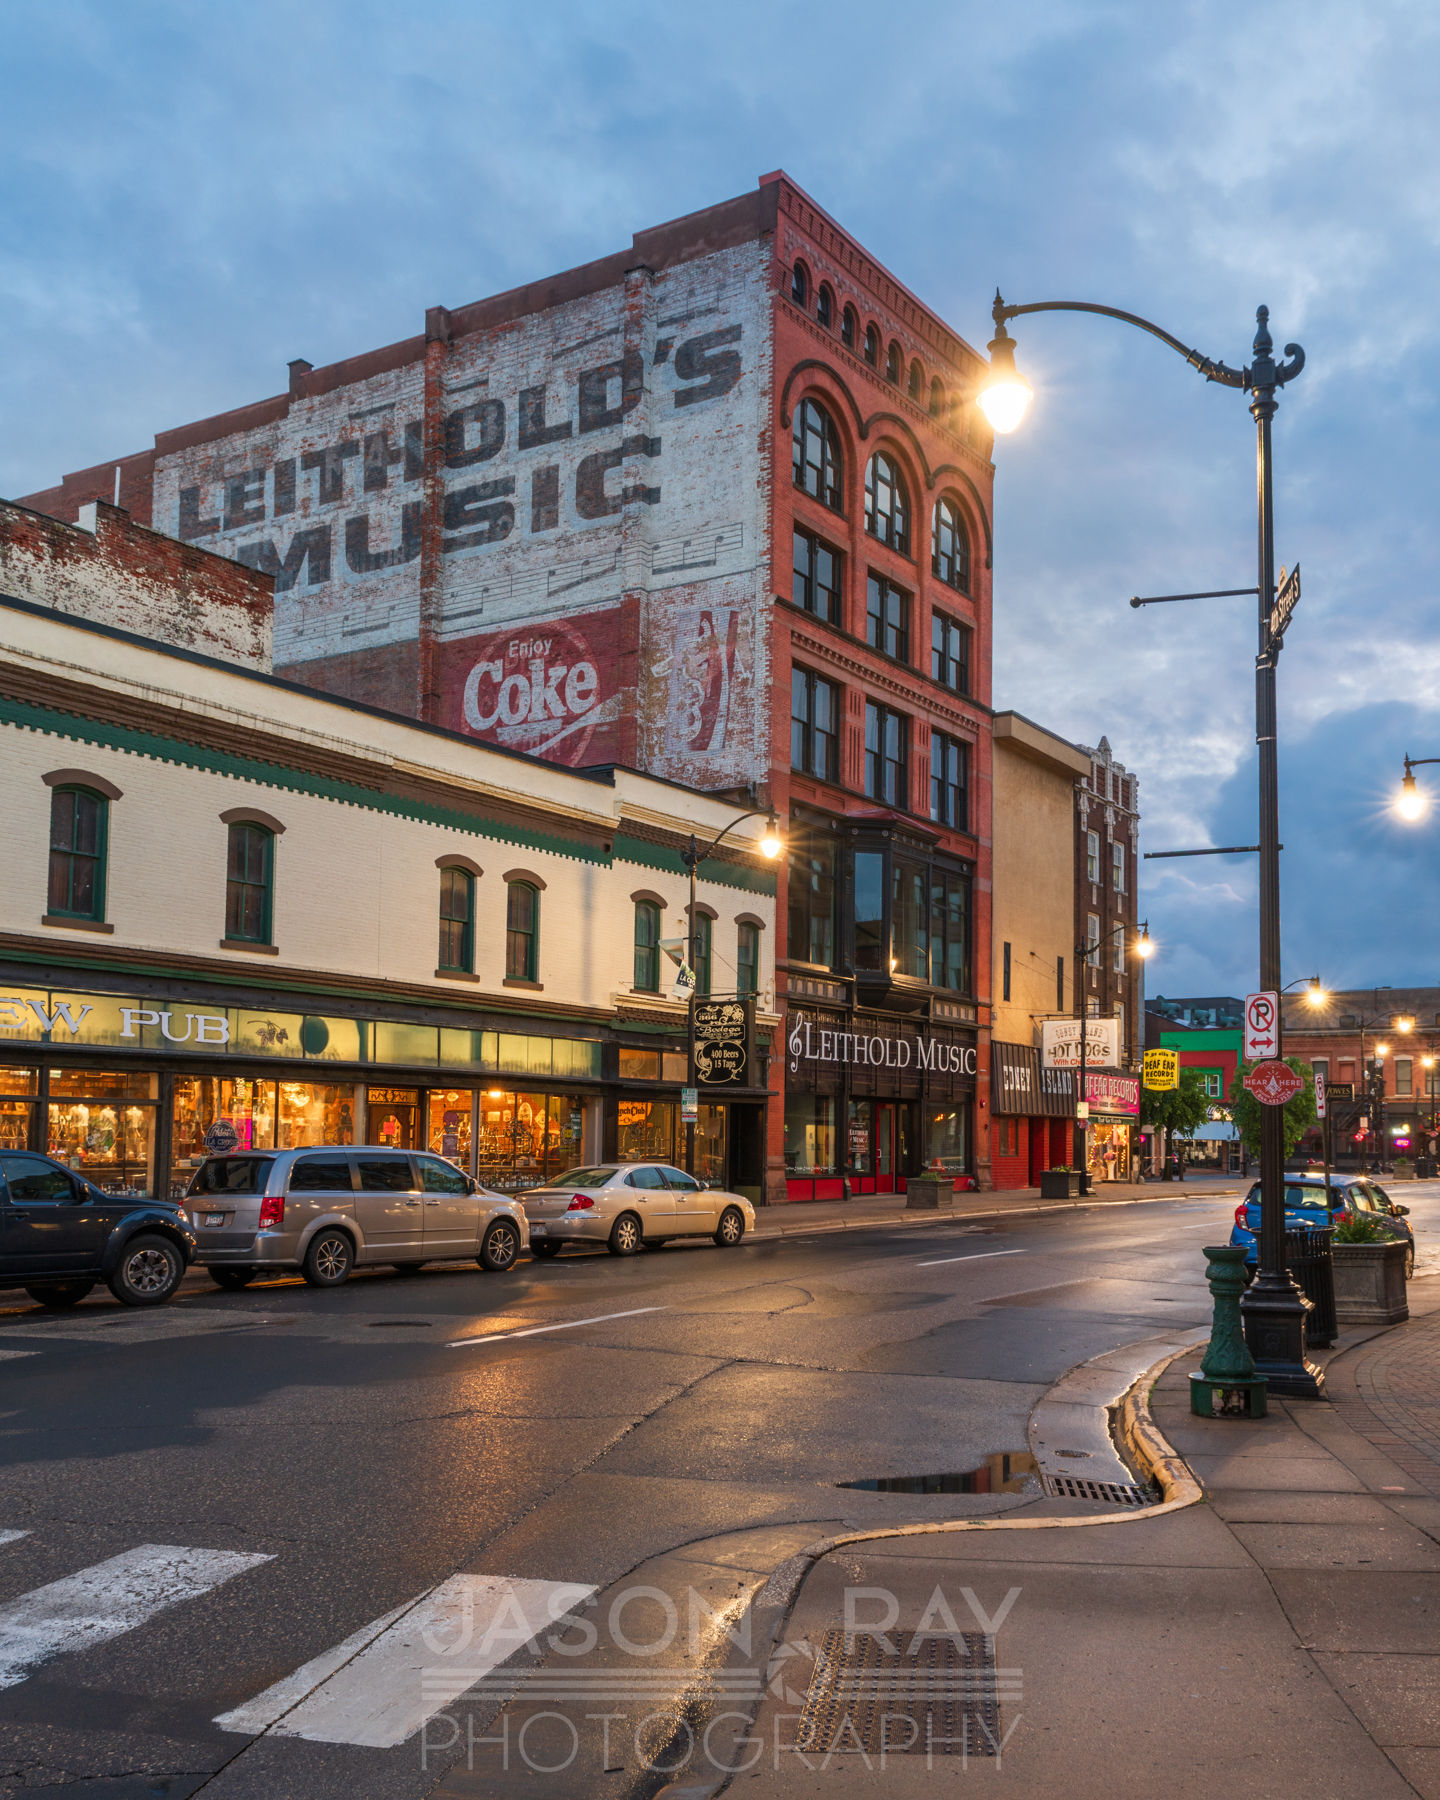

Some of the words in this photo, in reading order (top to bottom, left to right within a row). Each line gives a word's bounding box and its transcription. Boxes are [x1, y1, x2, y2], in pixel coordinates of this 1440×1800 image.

[178, 323, 742, 541] LEITHOLD'S
[237, 434, 662, 593] MUSIC
[1279, 580, 1294, 623] Street
[1293, 571, 1299, 598] S
[508, 638, 553, 658] Enjoy
[464, 658, 598, 731] Coke
[119, 1008, 229, 1044] PUB
[703, 1025, 741, 1033] Bodega
[711, 1049, 722, 1058] 400
[723, 1049, 739, 1058] Beers
[804, 1022, 911, 1067] LEITHOLD
[916, 1036, 976, 1075] MUSIC
[1048, 1043, 1072, 1058] HOT
[1053, 1058, 1068, 1066] With
[1086, 1058, 1105, 1066] Sauce
[714, 1060, 721, 1068] 15
[723, 1060, 736, 1070] Taps
[1145, 1060, 1161, 1070] DEAF
[1162, 1060, 1175, 1070] EAR
[1003, 1065, 1031, 1092] CONEY
[1042, 1069, 1072, 1095] ISLAND
[1108, 1079, 1138, 1106] RECORDS
